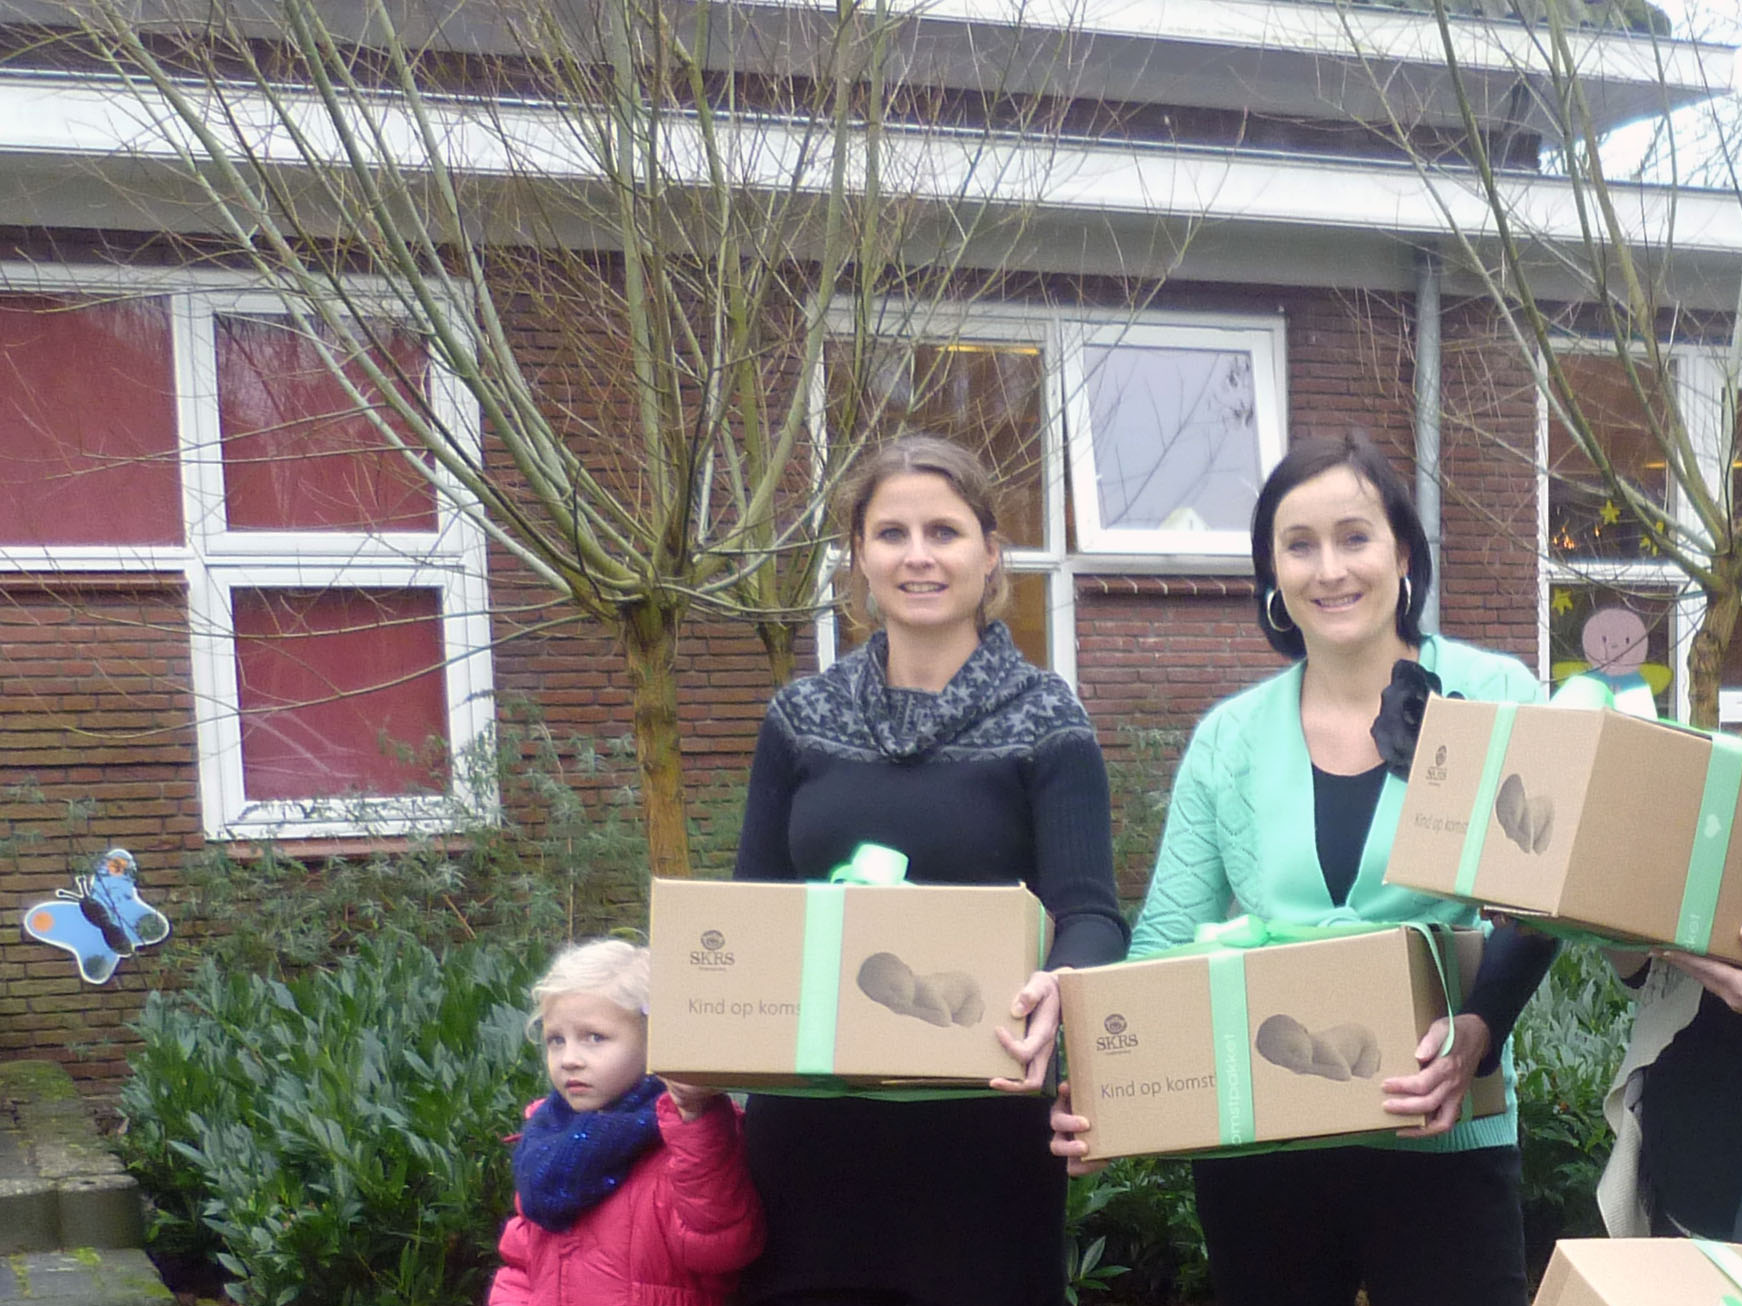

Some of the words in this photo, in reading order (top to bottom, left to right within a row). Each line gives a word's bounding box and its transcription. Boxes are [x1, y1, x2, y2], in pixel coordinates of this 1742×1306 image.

[689, 951, 735, 966] SKRS
[688, 998, 725, 1015] Kind
[730, 1002, 753, 1018] op
[1096, 1034, 1139, 1051] SKRS
[1100, 1080, 1136, 1099] Kind
[1140, 1081, 1162, 1097] op
[1166, 1073, 1217, 1092] komst
